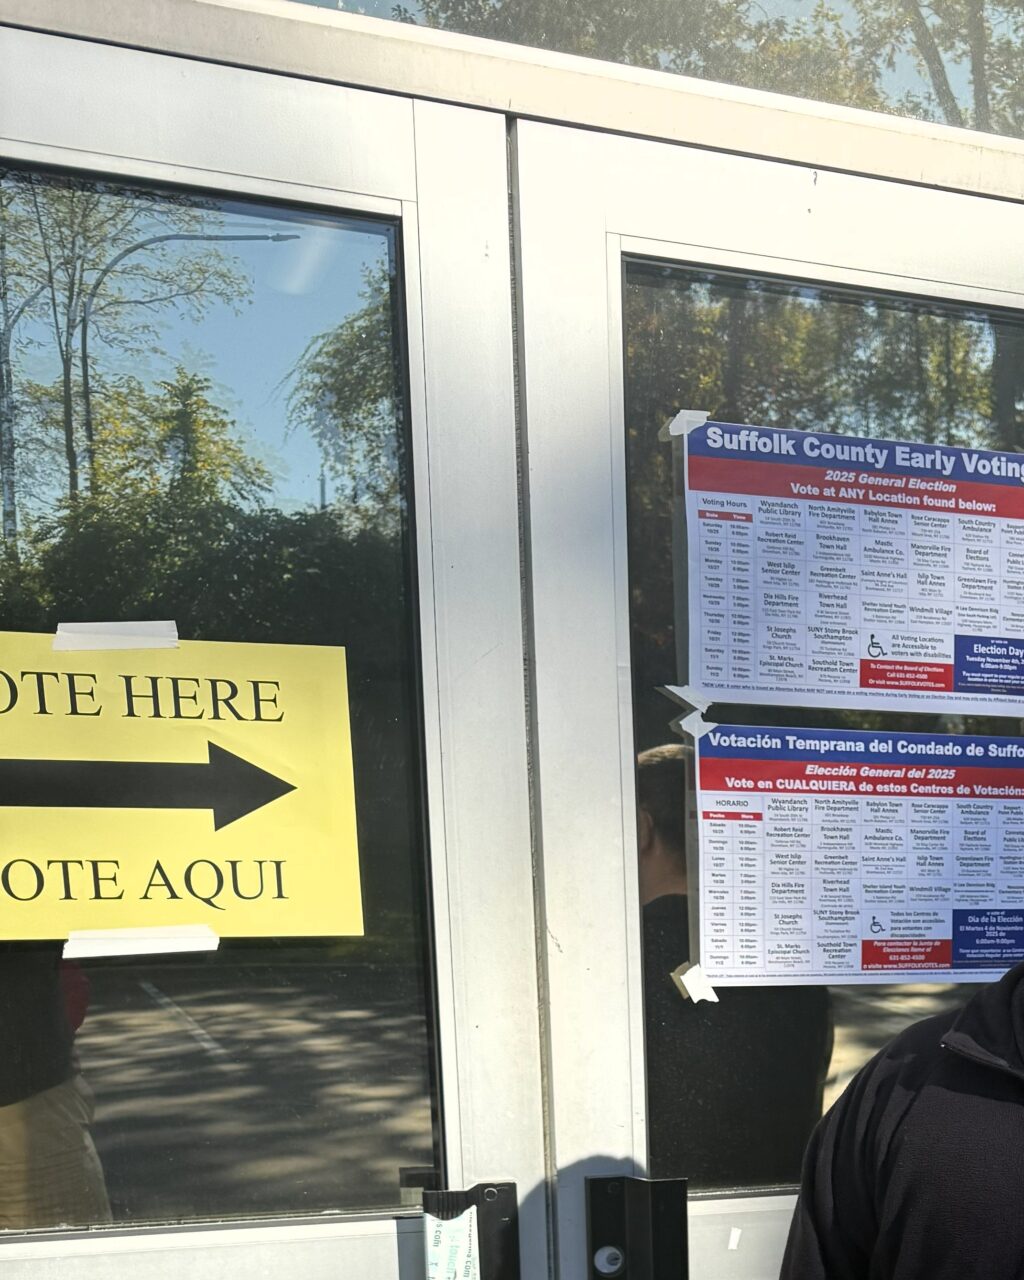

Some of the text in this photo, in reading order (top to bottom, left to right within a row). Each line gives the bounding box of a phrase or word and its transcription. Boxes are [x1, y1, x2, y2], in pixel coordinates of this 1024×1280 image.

[706, 427, 797, 455] Suffolk
[803, 437, 888, 469] County
[895, 446, 956, 475] Early
[824, 470, 957, 493] 2025 General Election
[791, 482, 996, 512] Vote at ANY Location found below:
[702, 498, 747, 508] Voting Hours
[760, 500, 798, 509] Wyandanch
[779, 507, 801, 517] Library
[827, 506, 855, 514] Amityville
[821, 511, 855, 520] Department
[975, 519, 996, 528] Country
[962, 525, 992, 533] Ambulance
[757, 536, 786, 544] Recreation
[816, 534, 850, 542] Brookhaven
[864, 546, 894, 554] Ambulance
[915, 550, 947, 558] Department
[781, 568, 800, 576] Center
[961, 583, 993, 591] Department
[764, 600, 799, 608] Department
[934, 607, 953, 615] Village
[814, 633, 852, 641] Southampton
[900, 635, 918, 643] Voting
[901, 642, 930, 650] Accessible
[974, 644, 1024, 657] Election Day
[923, 651, 952, 659] disabilities
[760, 660, 784, 668] Episcopal
[118, 674, 285, 722] HERE
[708, 732, 781, 749] Votación
[785, 736, 864, 753] Temprana
[869, 739, 893, 753] del
[897, 740, 962, 756] Condado
[966, 743, 983, 757] de
[805, 764, 956, 779] Elección General del 2025
[725, 777, 1024, 796] Vote en CUALQUIERA de estos Centros de Votación:
[139, 859, 289, 910] AQUI
